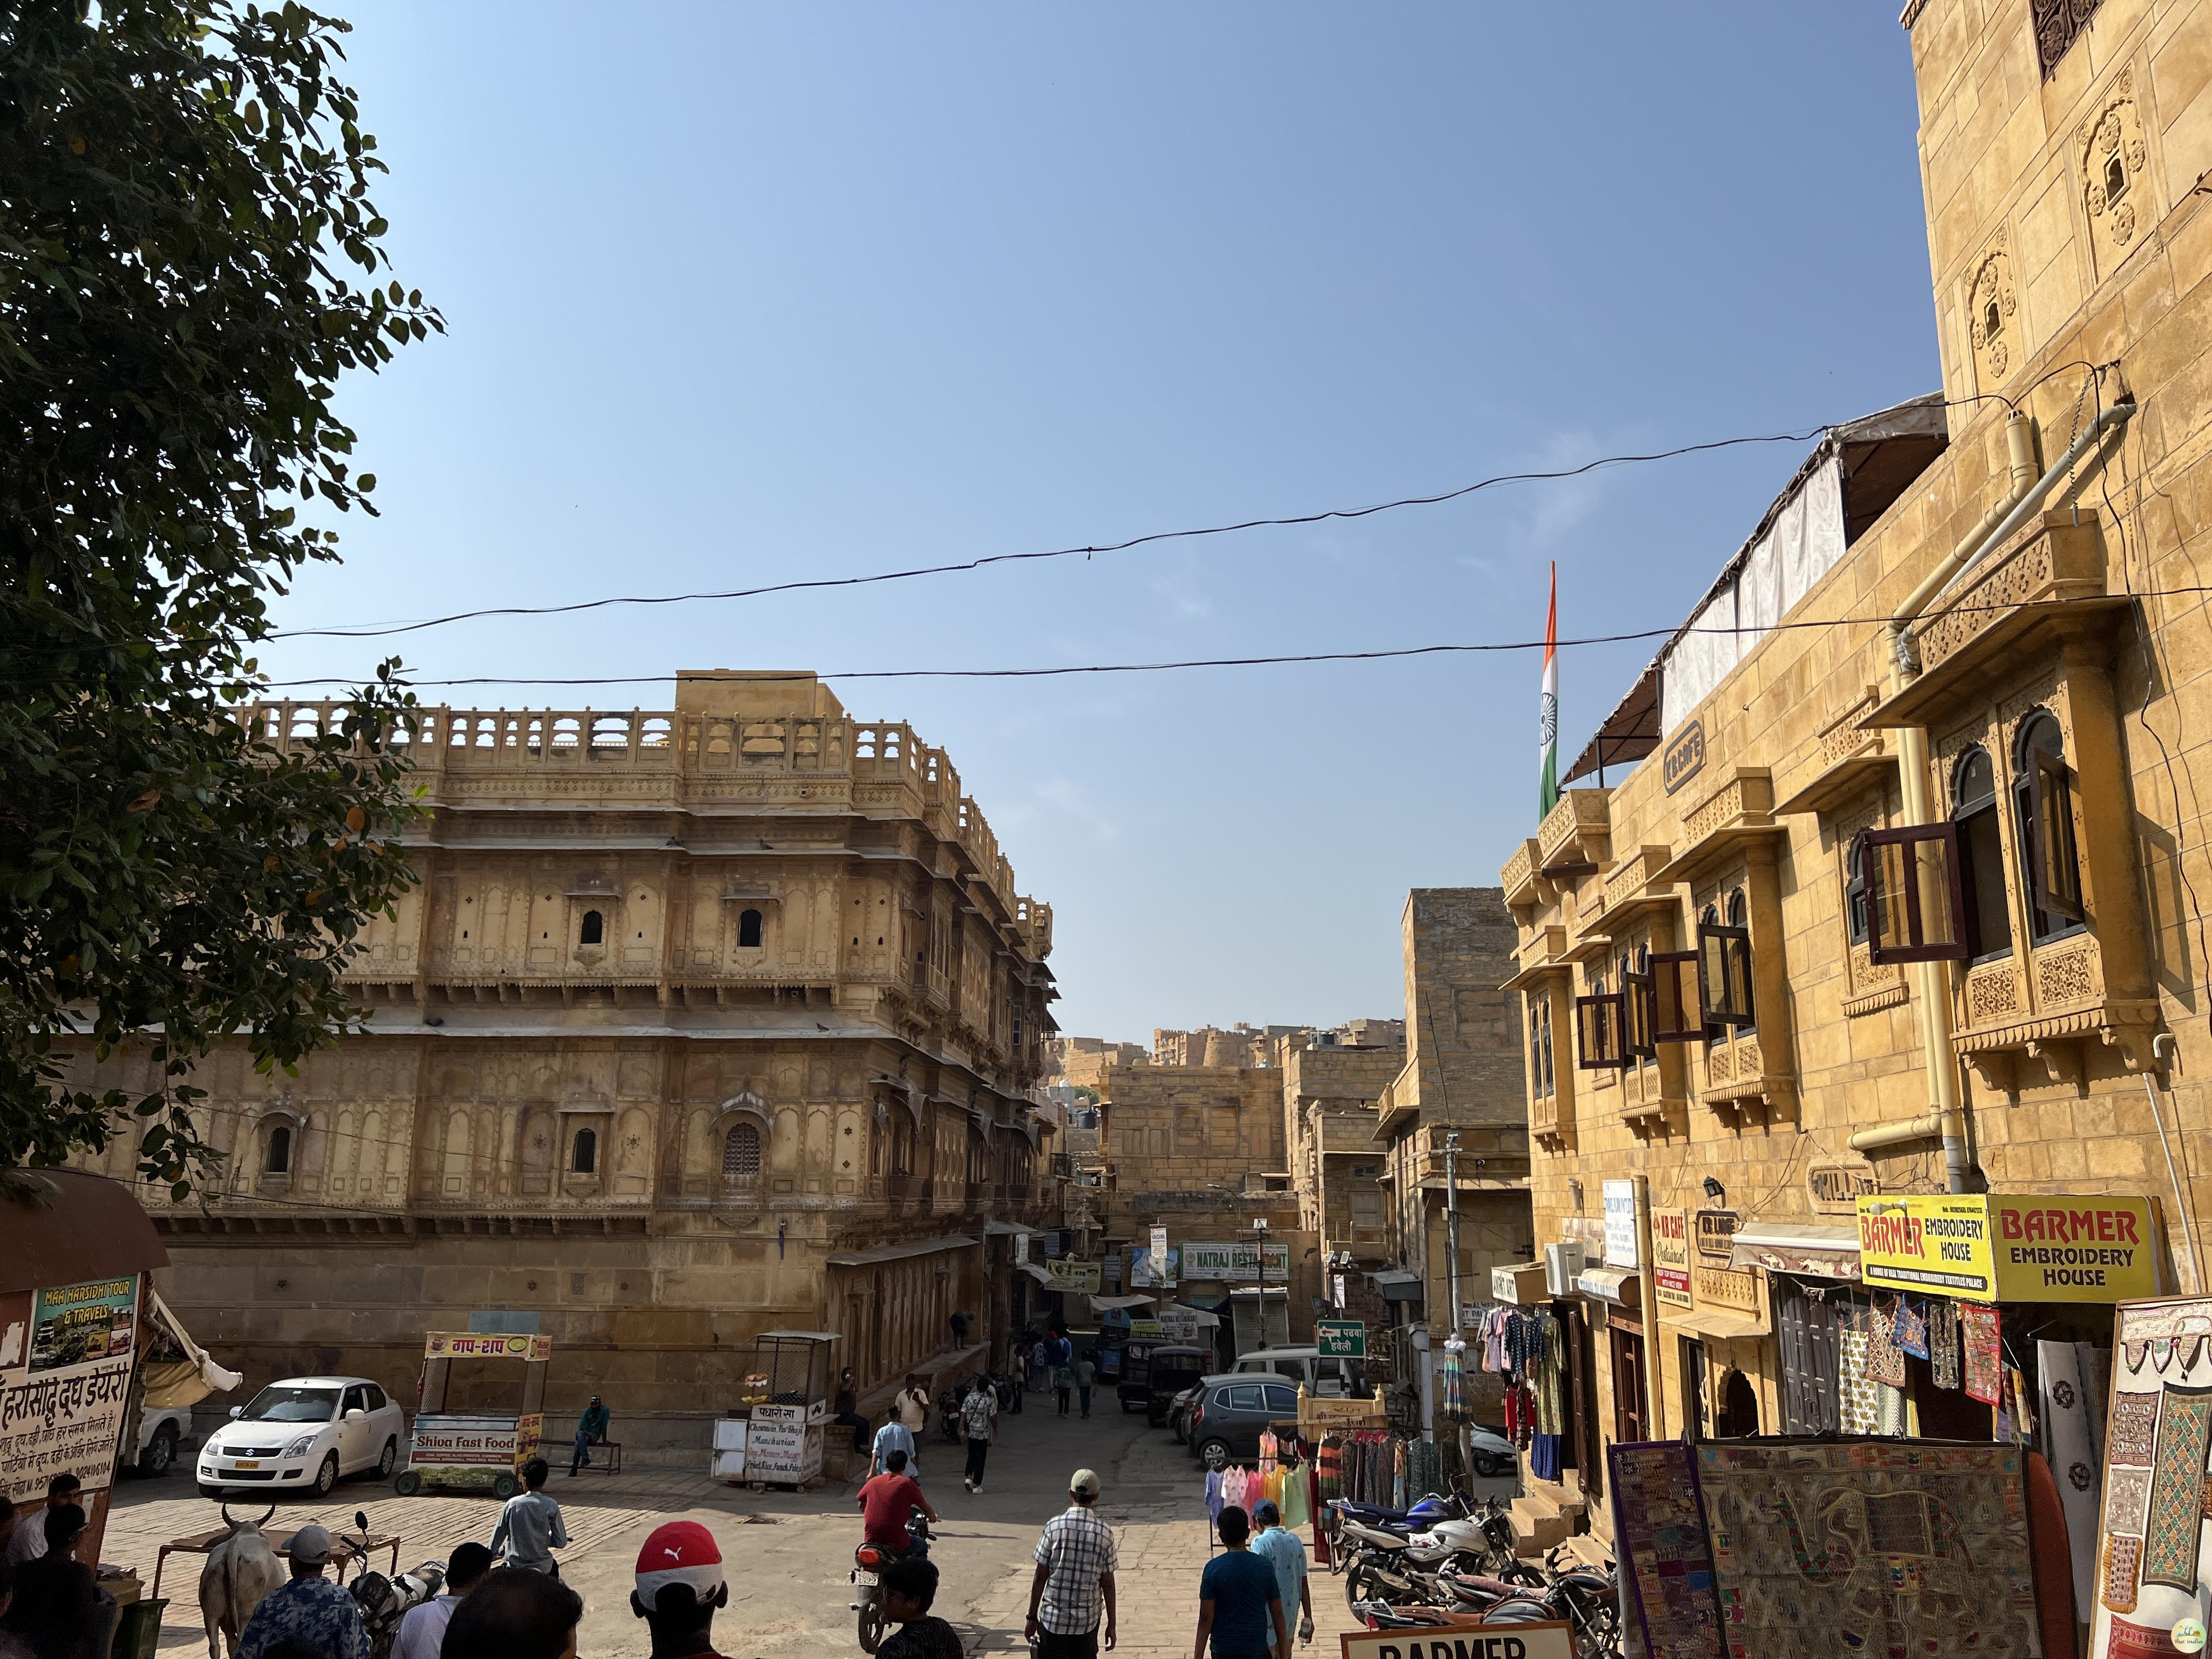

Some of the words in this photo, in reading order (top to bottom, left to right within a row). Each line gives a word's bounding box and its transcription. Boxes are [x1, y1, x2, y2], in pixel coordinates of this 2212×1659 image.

[1678, 732, 1700, 772] CAFE
[1661, 1215, 1669, 1238] KB
[1670, 1211, 1685, 1239] CAFÉ
[2001, 1209, 2140, 1246] BARMER
[1860, 1216, 1926, 1261] BARMER
[1925, 1218, 1983, 1240] EMBROIDERY
[1197, 1252, 1229, 1268] NATRAJ
[1232, 1252, 1287, 1268] RESTANT
[1656, 1241, 1686, 1266] Restaurant
[1940, 1242, 1971, 1262] HOUSE
[2011, 1247, 2134, 1267] EMBROIDERY
[1870, 1267, 1873, 1276] A
[1872, 1267, 1884, 1277] HOUSE
[1884, 1268, 1888, 1277] OF
[1966, 1278, 1983, 1289] PALACE
[2043, 1268, 2106, 1287] HOUSE
[44, 1289, 65, 1307] MAA
[66, 1283, 108, 1304] HARSIDHI
[109, 1280, 130, 1297] TOUR
[64, 1310, 72, 1324] &
[74, 1304, 109, 1323] TRAVELS
[452, 1339, 505, 1354] गप-शप
[1331, 1339, 1351, 1352] हवेली
[59, 1376, 87, 1420] दूध
[86, 1362, 130, 1407] डेयरी
[759, 1406, 783, 1418] पधारो
[783, 1409, 795, 1419] सा
[57, 1425, 68, 1444] हर
[67, 1422, 87, 1439] समय
[416, 1435, 453, 1448] Shiva
[456, 1436, 482, 1448] Fast
[485, 1437, 515, 1449] Food
[752, 1435, 795, 1446] Manchurian
